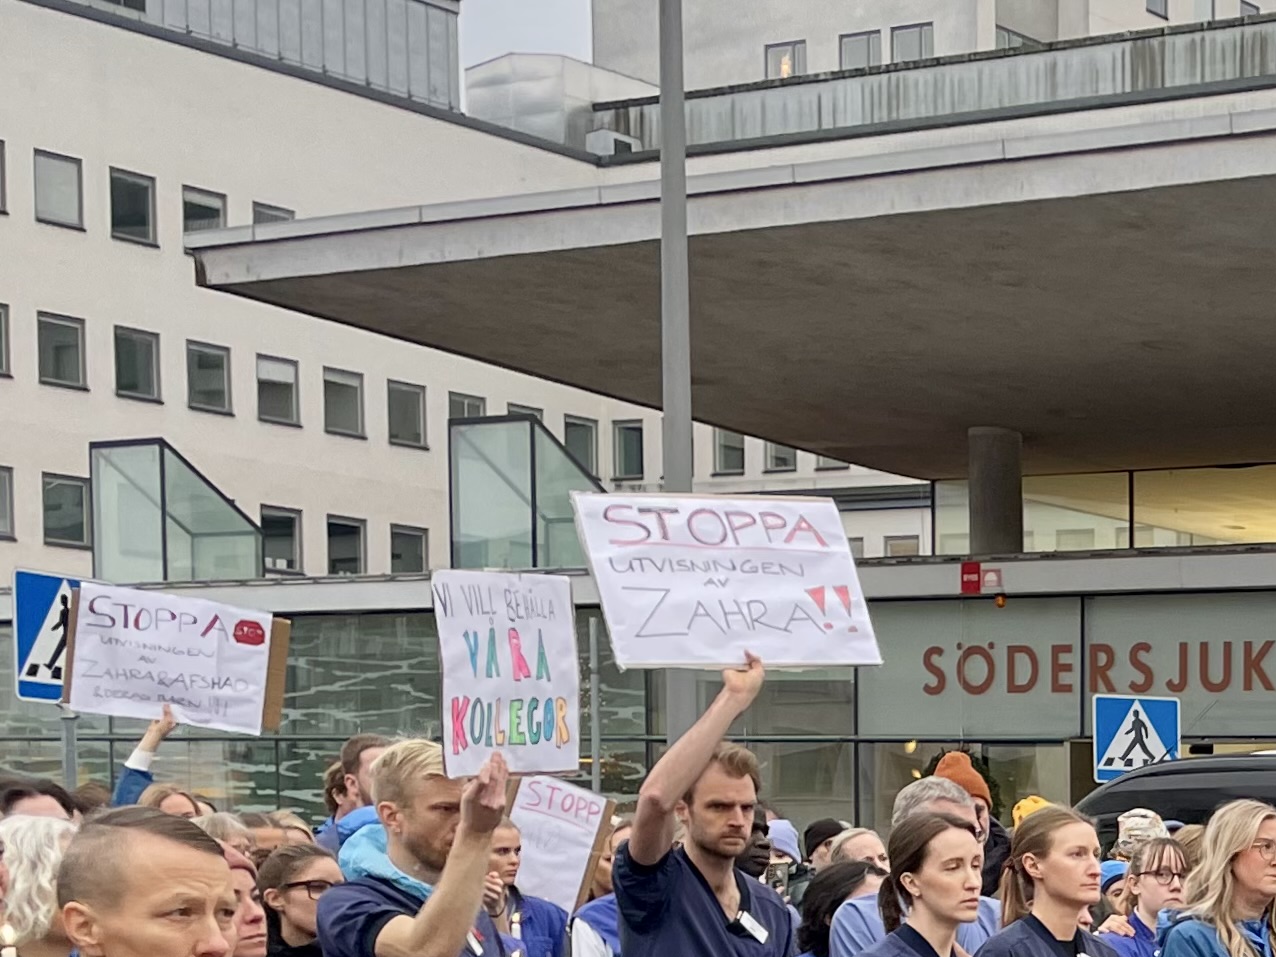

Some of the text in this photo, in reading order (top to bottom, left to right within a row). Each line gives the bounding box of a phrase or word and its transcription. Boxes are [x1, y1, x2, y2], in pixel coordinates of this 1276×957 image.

[603, 504, 829, 547] STOPPA
[609, 557, 804, 577] UTVISNINGEN
[703, 577, 730, 588] AV
[86, 595, 230, 642] STOPPA
[434, 583, 454, 617] VI
[460, 585, 497, 616] VILL
[463, 617, 551, 682] VÅRA
[451, 695, 570, 755] KOLLEGOR
[526, 781, 600, 822] STOPP
